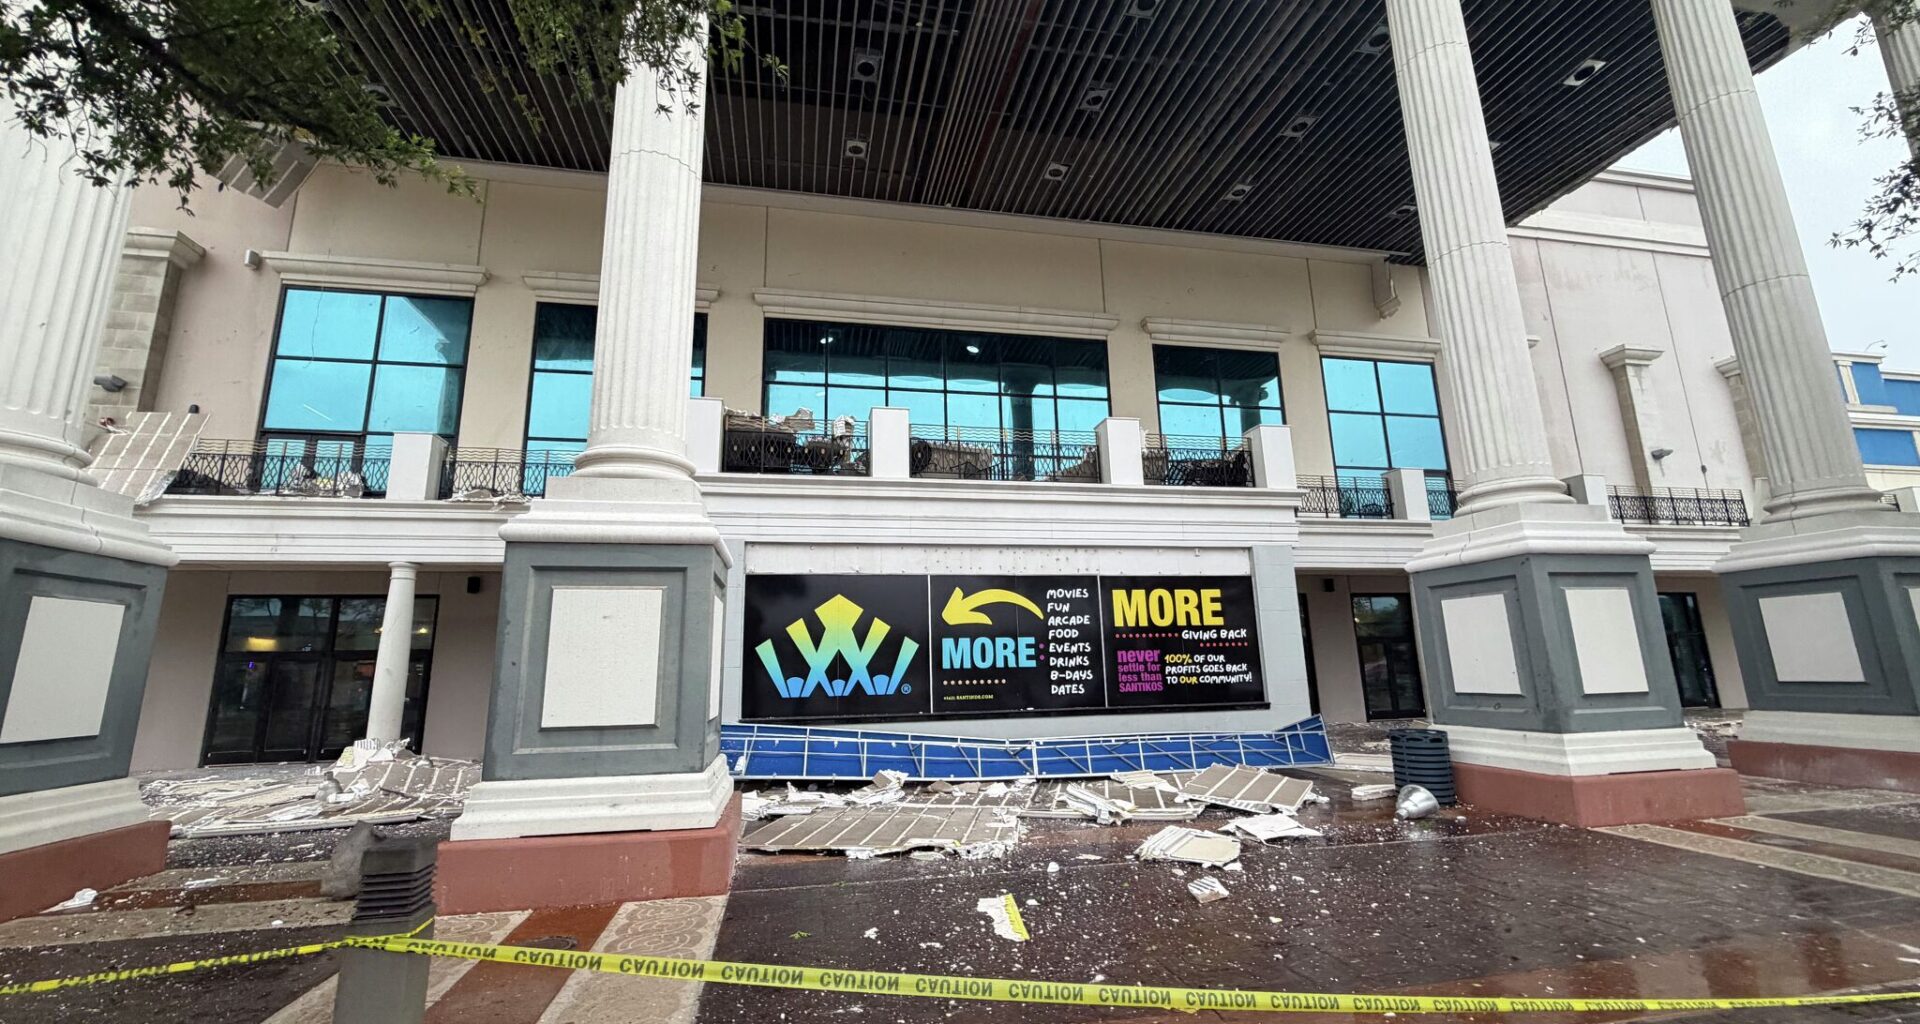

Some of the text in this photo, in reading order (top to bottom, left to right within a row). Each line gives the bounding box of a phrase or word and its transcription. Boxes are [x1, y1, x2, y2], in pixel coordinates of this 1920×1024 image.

[1046, 588, 1089, 599] MOVIES
[1047, 602, 1070, 613] FUN
[1112, 588, 1224, 627] MORE
[1048, 615, 1091, 626] ARCADE
[1048, 629, 1079, 640] FOOD
[1181, 628, 1247, 640] GIVING BACK
[1049, 642, 1091, 653] EVENTS
[1049, 655, 1090, 667] DRINKS
[1117, 649, 1160, 663] never
[1164, 653, 1226, 665] 100% OF OUR
[1117, 662, 1161, 672] settle for
[1165, 663, 1248, 674] PROFITS GOES BACK
[1050, 670, 1093, 681] B-DAYS
[1118, 671, 1162, 682] less than
[1166, 672, 1253, 685] TO OUR COMMUNITY!
[1051, 684, 1085, 695] DATES
[1119, 682, 1164, 693] SANTIKOS
